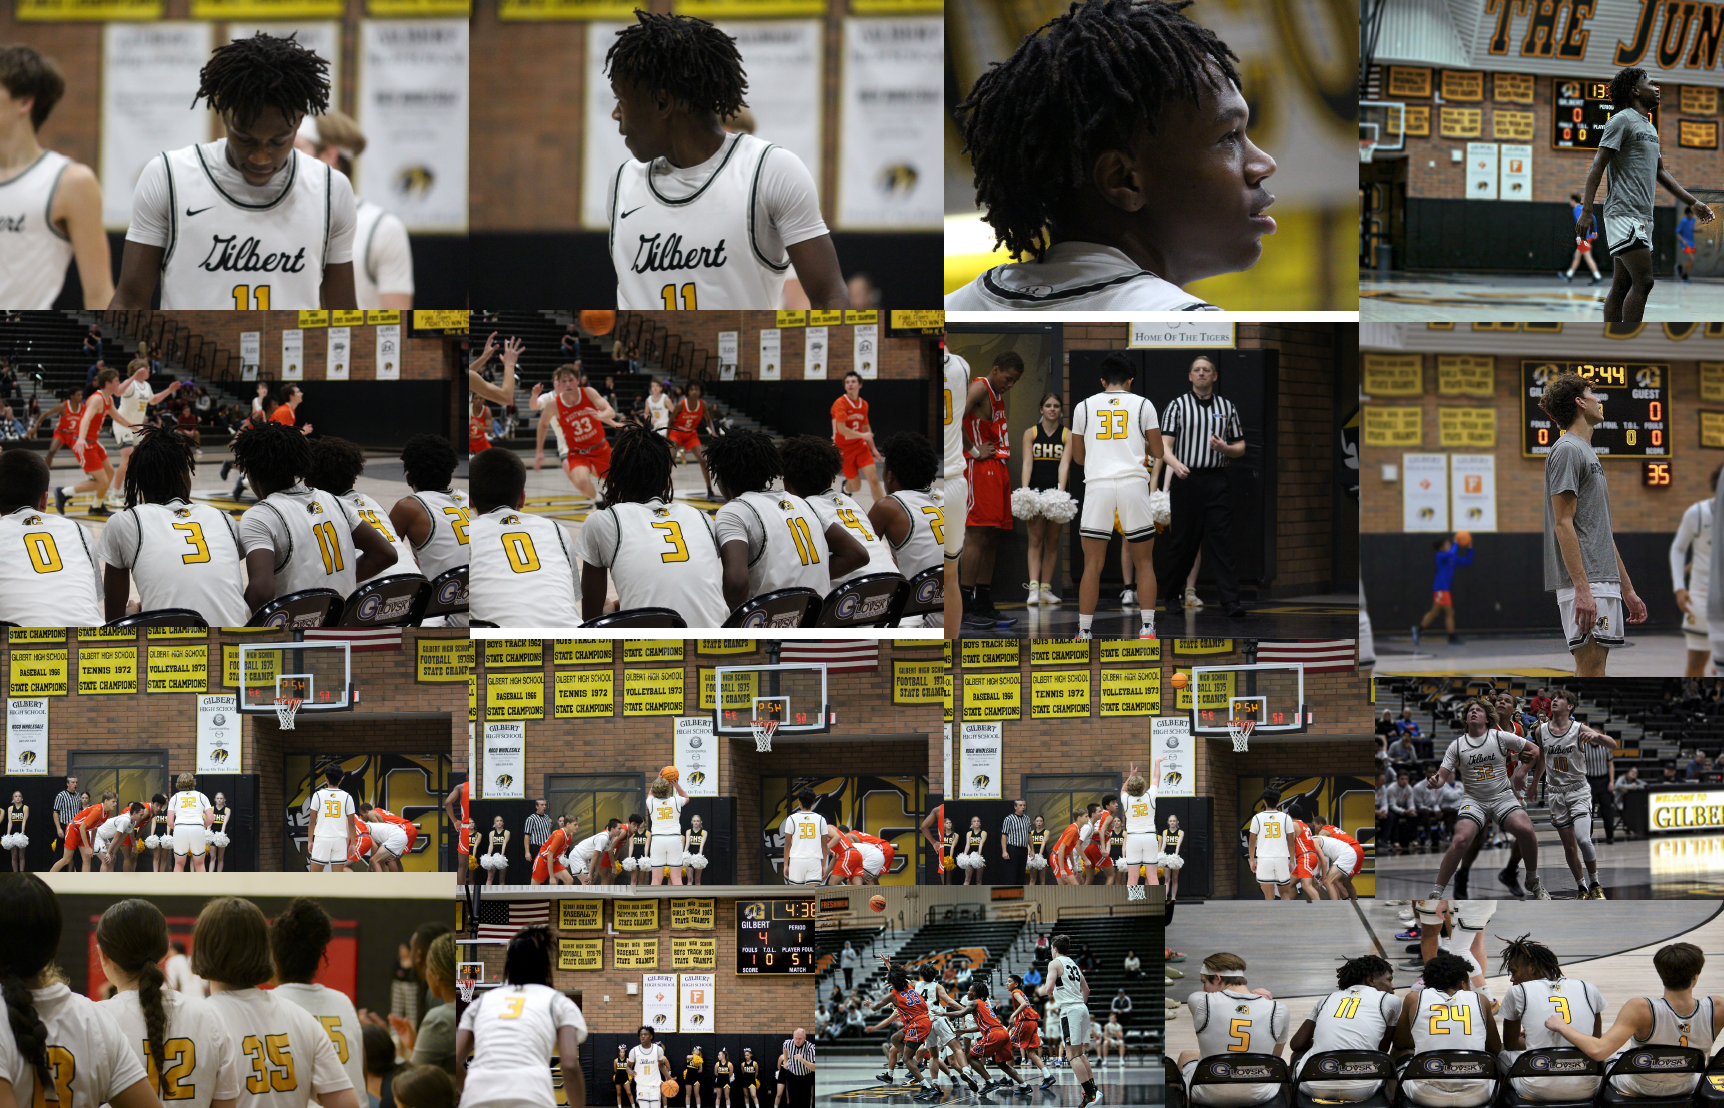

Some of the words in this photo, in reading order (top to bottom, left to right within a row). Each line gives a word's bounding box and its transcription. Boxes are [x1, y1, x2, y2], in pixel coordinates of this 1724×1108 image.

[1486, 0, 1597, 60] THE
[1572, 107, 1583, 123] 0
[1563, 128, 1572, 140] 0
[1578, 129, 1587, 140] 0
[198, 234, 306, 273] Gilbert
[630, 232, 727, 274] Gilbert
[232, 284, 271, 310] 11
[660, 282, 697, 310] 11
[1135, 332, 1162, 342] HOME
[1164, 332, 1177, 342] OF
[1179, 332, 1198, 342] THE
[1200, 332, 1230, 342] TIGERS
[1577, 365, 1625, 384] 12:44
[1632, 388, 1661, 399] GUEST
[1649, 401, 1662, 421] 0
[68, 420, 77, 430] 3
[571, 417, 593, 436] 33
[852, 421, 860, 432] 2
[1096, 409, 1129, 440] 33
[1538, 428, 1549, 445] 0
[1626, 429, 1637, 446] 0
[1651, 429, 1662, 446] 0
[1032, 443, 1064, 458] GHS
[1648, 464, 1670, 485] 35
[358, 509, 396, 542] 4
[837, 508, 874, 541] 4
[171, 521, 212, 564] 3
[313, 520, 345, 575] 11
[650, 521, 691, 564] 3
[785, 516, 821, 567] 11
[23, 531, 64, 574] 0
[500, 532, 541, 574] 0
[356, 592, 415, 621] GLOVSKY
[835, 592, 893, 620] GLOVSKY
[703, 640, 721, 648] STATE
[724, 639, 748, 648] CHAMPS
[420, 655, 452, 664] FOOTBALL
[150, 665, 190, 673] VOLLEYBALL
[192, 664, 205, 672] 1973
[11, 683, 28, 692] STATE
[31, 683, 66, 691] CHAMPIONS
[79, 681, 97, 690] STATE
[100, 680, 136, 689] CHAMPIONS
[148, 680, 166, 688] STATE
[169, 679, 206, 688] CHAMPIONS
[897, 677, 928, 686] FOOTBALL
[1214, 683, 1226, 692] 1975
[496, 692, 523, 700] BASEBALL
[592, 689, 607, 697] 1972
[626, 688, 666, 696] VOLLEYBALL
[726, 694, 750, 703] CHAMPS
[1203, 694, 1227, 703] CHAMPS
[487, 707, 505, 716] STATE
[507, 706, 543, 715] CHAMPIONS
[556, 705, 573, 713] STATE
[576, 704, 612, 713] CHAMPIONS
[624, 703, 642, 711] STATE
[645, 702, 683, 711] CHAMPIONS
[1547, 744, 1573, 755] Gilbert
[1468, 752, 1497, 765] Gilbert
[1553, 757, 1568, 772] 10
[1473, 764, 1496, 781] 32
[181, 796, 196, 808] 32
[1655, 793, 1695, 803] WELCOME
[1696, 792, 1708, 802] TO
[325, 800, 341, 818] 33
[657, 807, 673, 820] 32
[1132, 804, 1148, 817] 32
[799, 823, 816, 839] 33
[1264, 822, 1281, 838] 33
[820, 899, 849, 910] FRESHMEN
[759, 932, 767, 945] 4
[798, 933, 801, 942] 1
[753, 954, 755, 964] 1
[766, 953, 773, 965] 0
[792, 953, 799, 965] 5
[809, 954, 812, 964] 1
[1067, 964, 1081, 983] 33
[900, 989, 921, 1006] 33
[499, 997, 525, 1019] 3
[1334, 997, 1361, 1019] 11
[1548, 996, 1572, 1025] 3
[1429, 1003, 1472, 1035] 24
[1227, 1018, 1252, 1052] 5
[242, 1032, 298, 1094] 35
[1319, 1057, 1381, 1073] GLOVSKY
[1423, 1058, 1484, 1074] GLOVSKY
[1529, 1055, 1590, 1071] GLOVSKY
[1632, 1053, 1693, 1069] GLOVSKY
[644, 1066, 650, 1075] 11
[1210, 1061, 1273, 1078] GLOVSKY
